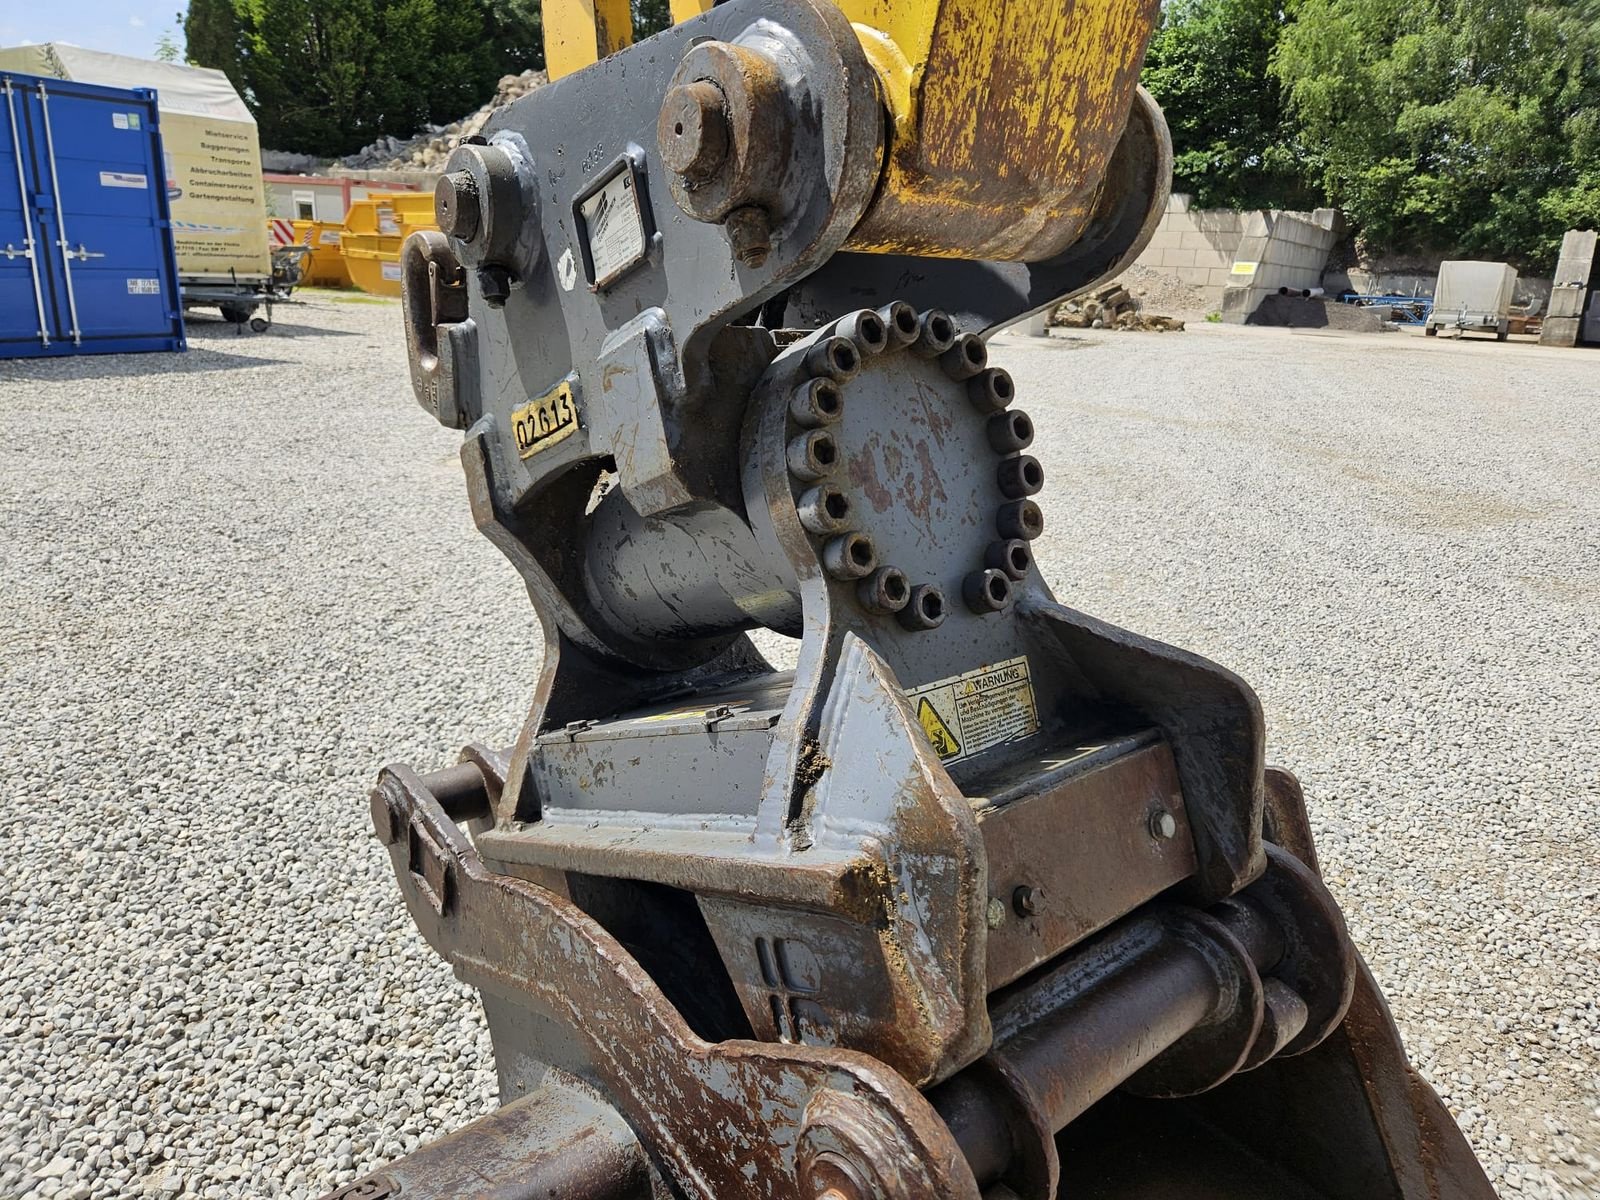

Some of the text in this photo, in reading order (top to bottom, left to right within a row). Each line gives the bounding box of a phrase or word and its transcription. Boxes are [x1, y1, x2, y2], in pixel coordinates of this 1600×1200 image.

[205, 130, 248, 140] Mietservice
[200, 142, 250, 153] Baggerungen
[210, 156, 250, 166] Transporte
[190, 166, 252, 178] Abbrucharbeiten
[189, 180, 253, 190] Containerservice
[189, 192, 254, 204] Gartengestaltung
[974, 667, 1020, 691] WARNUNG
[1006, 682, 1026, 692] Personen
[961, 712, 983, 722] Maschine
